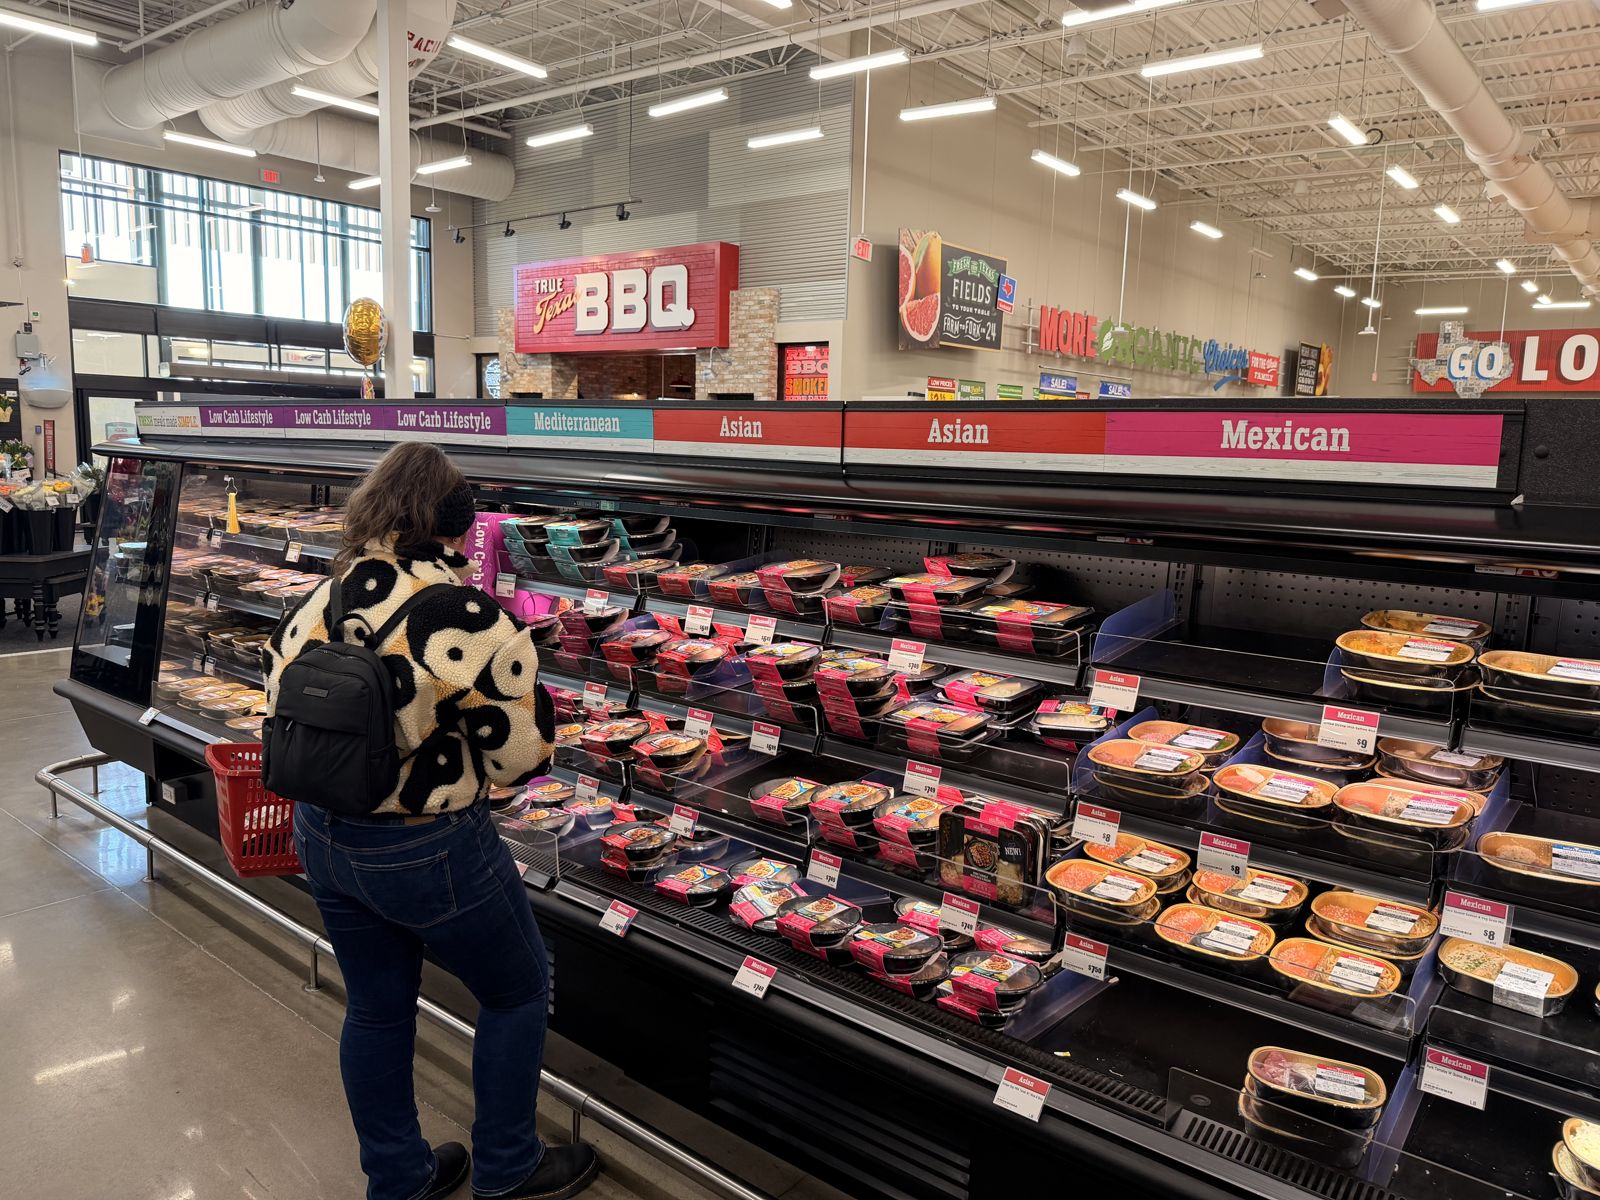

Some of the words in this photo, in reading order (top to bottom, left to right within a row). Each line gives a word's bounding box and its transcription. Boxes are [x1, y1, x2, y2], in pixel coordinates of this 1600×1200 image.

[979, 260, 996, 281] TEXAS
[534, 277, 565, 294] TRUE
[952, 279, 991, 305] FIELDS
[533, 287, 583, 335] Texas
[574, 264, 695, 335] BBQ
[960, 305, 973, 313] YOUR
[943, 316, 960, 334] FARM
[965, 320, 982, 337] FORK
[986, 321, 997, 341] 24
[1039, 305, 1098, 358] MORE
[1203, 339, 1249, 374] Choices
[1447, 345, 1504, 380] GO
[208, 410, 223, 424] Low
[223, 410, 240, 424] Carb
[240, 410, 273, 426] Lifestyle
[294, 410, 312, 425] Low
[312, 410, 332, 425] Carb
[332, 409, 371, 428] Lifestyle
[397, 410, 416, 427] Low
[418, 411, 442, 428] Carb
[442, 411, 491, 432] Lifestyle
[534, 411, 620, 433] Mediterranean
[719, 415, 763, 439] Asian
[927, 418, 989, 445] Asian
[1221, 419, 1351, 454] Mexican
[474, 522, 488, 549] Low
[1109, 675, 1125, 683] Asian
[1337, 711, 1365, 722] Mexican
[1356, 739, 1368, 748] $9
[915, 764, 932, 773] Mexican
[1091, 808, 1107, 817] Asian
[1102, 832, 1111, 842] $8
[1213, 837, 1237, 849] Mexican
[1005, 847, 1021, 856] NEW!
[1231, 864, 1240, 874] $8
[951, 897, 970, 909] Mexican
[1460, 898, 1491, 912] Mexican
[1483, 929, 1495, 941] $8
[1079, 940, 1094, 950] Asian
[1441, 1055, 1472, 1071] Mexican
[1018, 1076, 1035, 1087] Asian
